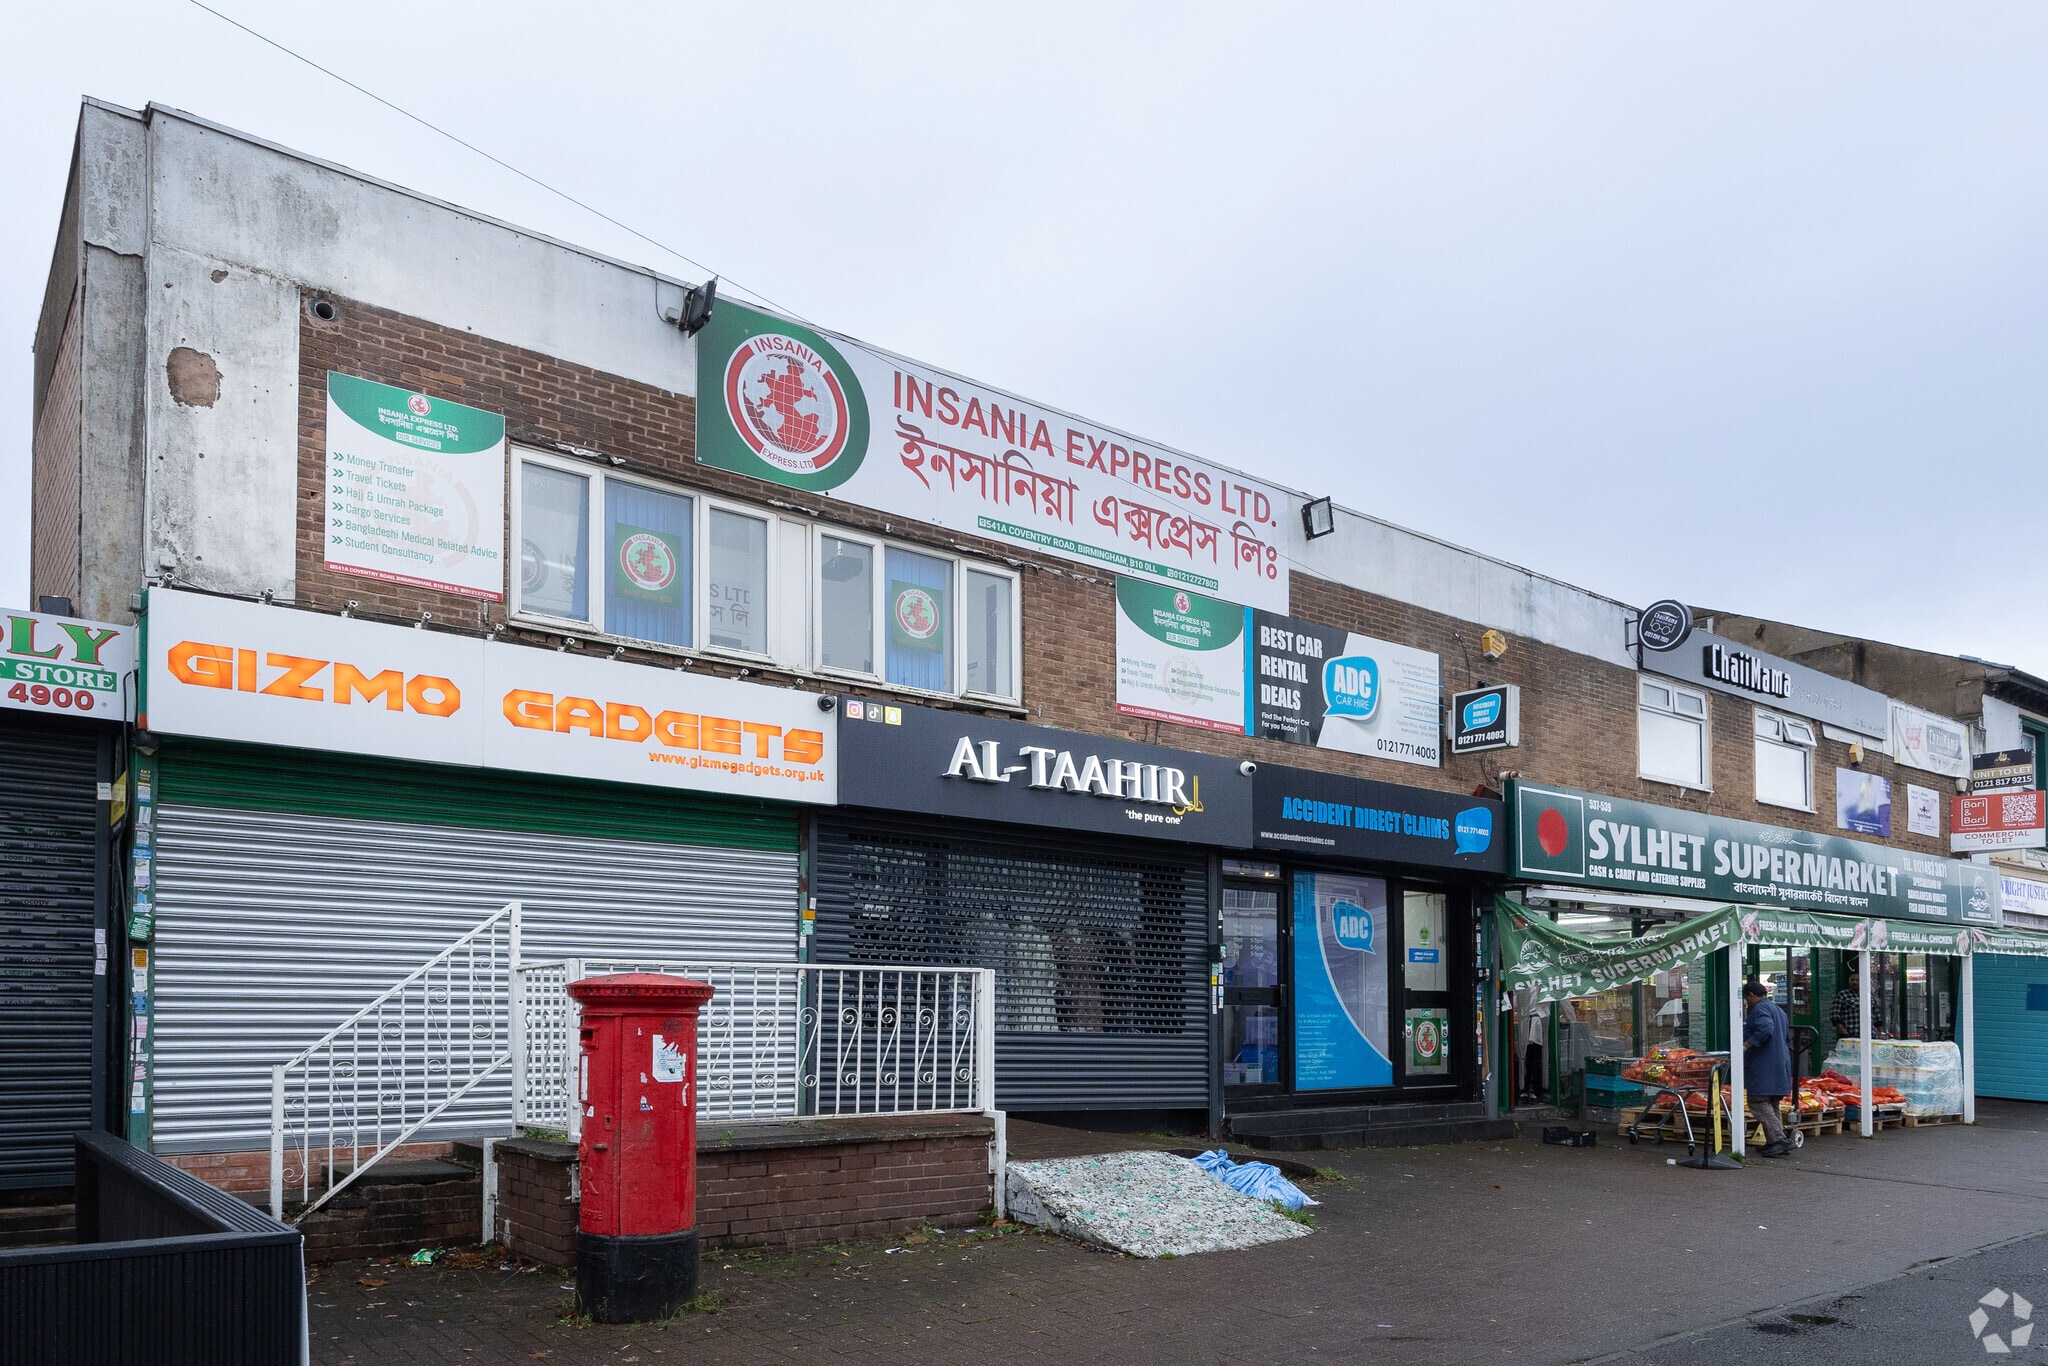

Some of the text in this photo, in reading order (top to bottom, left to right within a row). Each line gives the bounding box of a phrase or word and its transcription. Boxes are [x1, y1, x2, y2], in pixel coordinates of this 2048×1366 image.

[754, 337, 823, 372] INSANIA
[378, 407, 458, 433] INSANIA EXPRESS LTD.
[398, 433, 440, 449] OUR SERVICES
[894, 371, 1277, 528] INSANIA EXPRESS LTD.
[346, 454, 414, 477] Money Transfer
[347, 470, 406, 492] Travel Tickets
[895, 414, 1080, 525] ইনসানিয়া
[1093, 495, 1221, 565] এক্সপ্রেস
[346, 487, 444, 516] Hajj & Umrah Package
[345, 504, 411, 525] Cargo Services
[345, 520, 497, 559] Bangladeshi Medical Related Advice
[345, 537, 434, 563] Student Consultancy
[633, 534, 664, 548] INSANIA
[986, 520, 1007, 533] 541A
[1009, 526, 1051, 544] COVENTRY
[1053, 537, 1077, 552] ROAD,
[1078, 544, 1128, 567] BIRMINGHAM,
[1130, 557, 1145, 570] B10
[1173, 569, 1217, 589] 01212727802
[350, 568, 379, 577] COVENTRY
[397, 576, 433, 587] BIRMINGHAM,
[1153, 609, 1175, 620] INSANIA
[1176, 615, 1200, 625] EXPRESS
[0, 616, 120, 666] LY
[1261, 626, 1322, 659] BEST CAR
[16, 663, 114, 690] STORE
[168, 640, 461, 718] GIZMO
[1261, 655, 1308, 684] RENTAL
[1708, 643, 1791, 698] ChaiiMama
[1334, 664, 1371, 699] ADC
[8, 683, 94, 711] 4900
[1261, 684, 1300, 710] DEALS
[1336, 696, 1370, 710] CAR HIRE
[502, 688, 824, 765] GADGETS
[1262, 712, 1271, 721] Find
[1273, 713, 1281, 723] The
[1283, 715, 1300, 726] Perfect
[1262, 720, 1298, 734] For you Today!
[1377, 738, 1436, 760] 01217714003
[1458, 730, 1504, 745] 0121 771 4003
[648, 751, 824, 782] www.gizmogadgets.org.uk
[942, 736, 1194, 806] AL-TAAHIR
[1974, 766, 2032, 779] UNIT TO LET
[1975, 776, 2032, 788] 0121 817 9215
[1589, 800, 1612, 813] 537-539
[1964, 800, 1985, 809] Bari
[1145, 813, 1163, 823] pure
[1282, 797, 1450, 840] ACCIDENT DIRECT CLAIMS
[1964, 816, 1985, 824] Bari
[1458, 825, 1489, 837] 0121 7714003
[1965, 831, 2030, 840] COMMERCIAL
[1589, 819, 1898, 897] SYLHET SUPERMARKET
[1589, 865, 1706, 889] CASH & CARRY AND CATERING SUPPLIES
[2027, 883, 2048, 901] JUSTIC
[1340, 916, 1369, 939] ADC
[1759, 920, 1777, 932] FRESH
[1778, 922, 1795, 933] HALAL
[1891, 932, 1953, 944] FRESH HALAL CHICKEN
[1591, 920, 1730, 982] SUPERMARKET
